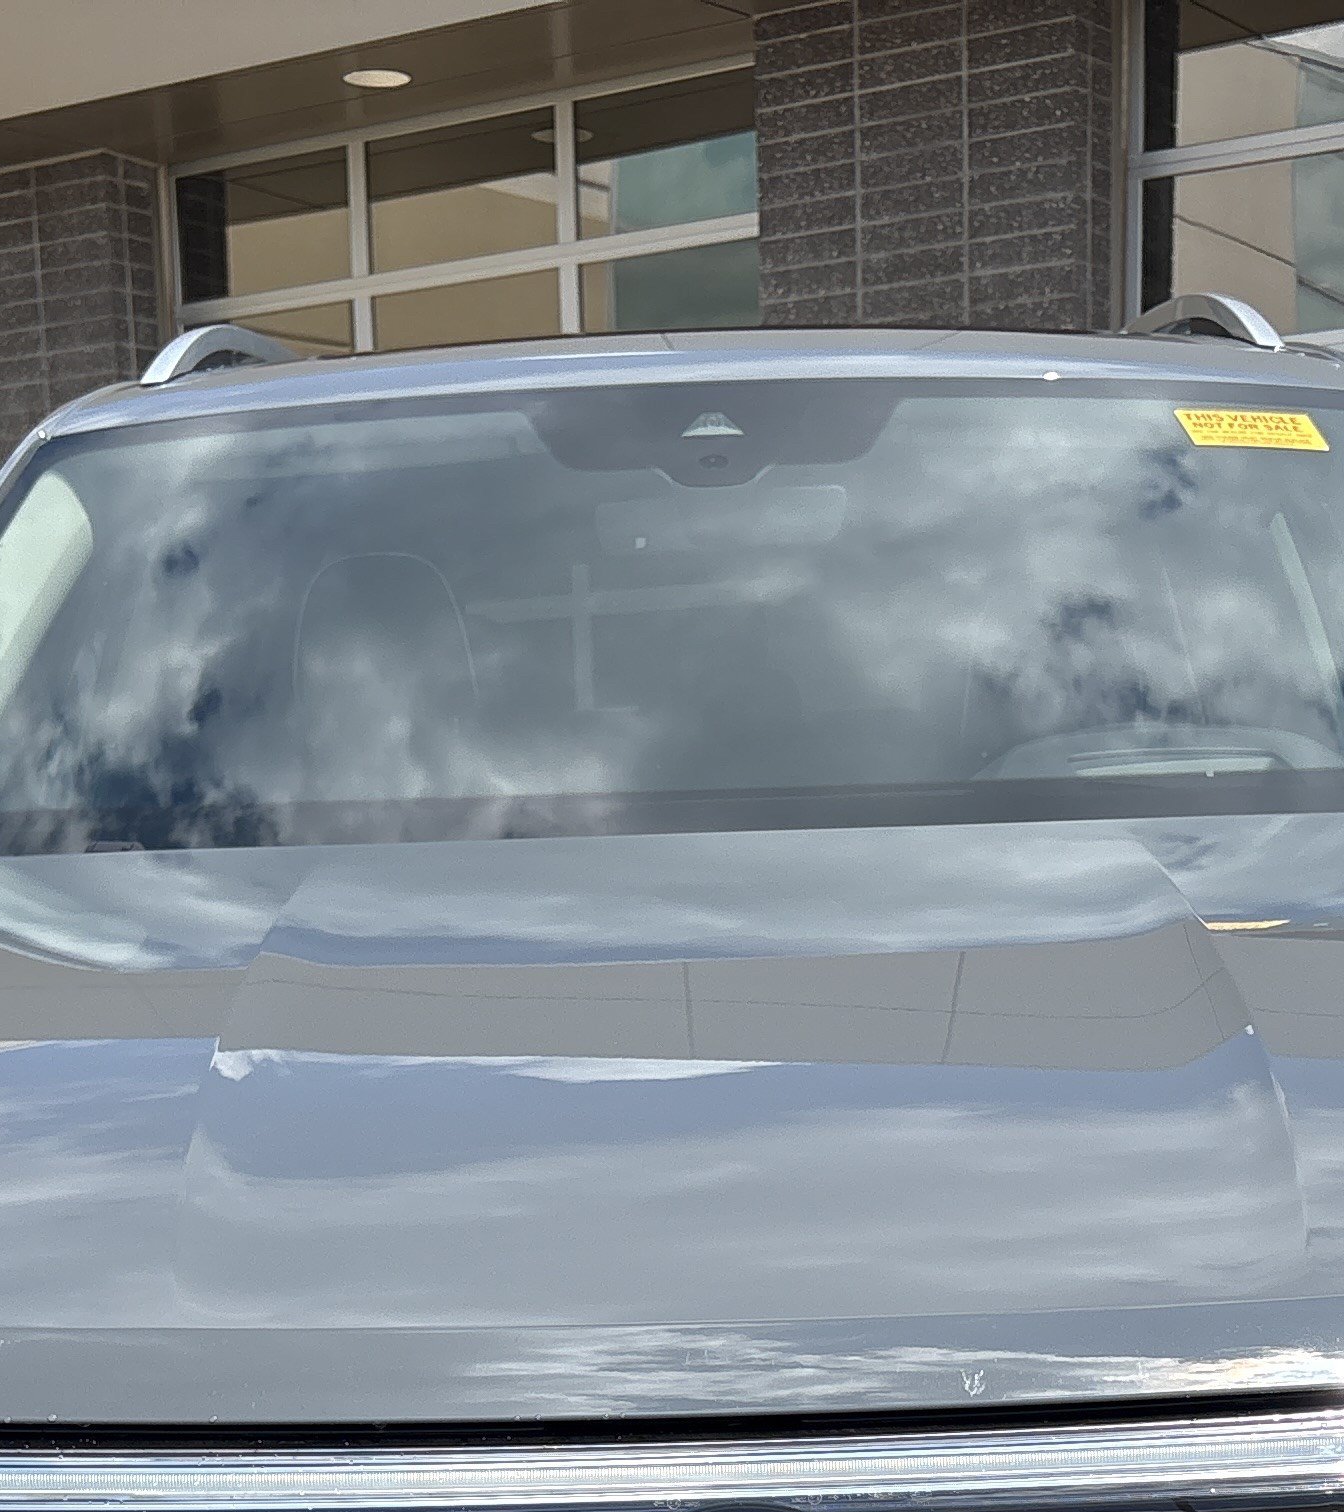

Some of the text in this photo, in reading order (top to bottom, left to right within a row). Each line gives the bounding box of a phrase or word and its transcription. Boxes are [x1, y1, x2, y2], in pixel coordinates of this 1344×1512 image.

[1183, 413, 1302, 425] THIS VEHICLE
[1263, 424, 1304, 432] SALE
